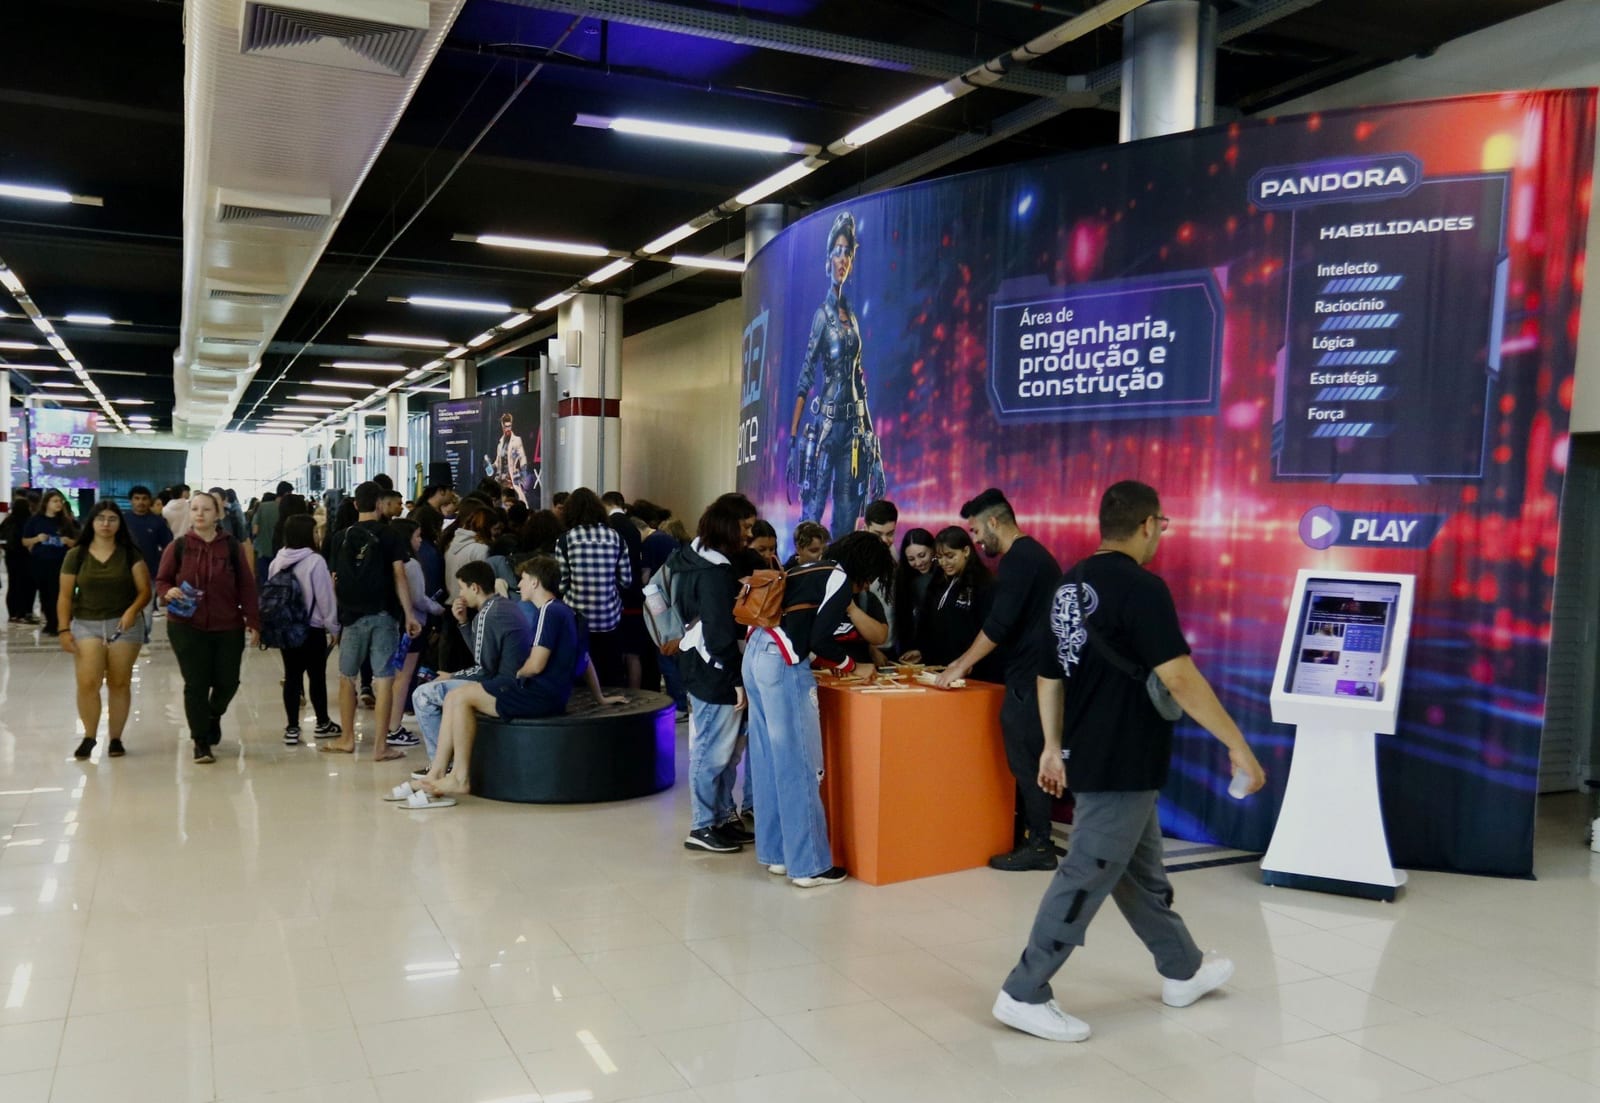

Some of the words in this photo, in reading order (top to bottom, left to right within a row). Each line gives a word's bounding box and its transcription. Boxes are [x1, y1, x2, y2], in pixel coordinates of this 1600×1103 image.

[1260, 166, 1407, 199] PANDORA
[1319, 216, 1474, 240] HABILIDADES
[1317, 262, 1378, 277] Intelecto
[1019, 308, 1052, 327] Área
[1055, 306, 1074, 323] de
[1314, 298, 1385, 314] Raciocínio
[1020, 315, 1176, 354] engenharia,
[1312, 336, 1355, 351] Lógica
[1019, 344, 1139, 380] produção
[1149, 345, 1167, 364] e
[1018, 366, 1163, 398] construção
[1310, 371, 1378, 386] Estratégia
[1307, 408, 1345, 422] Força
[1350, 518, 1419, 543] PLAY
